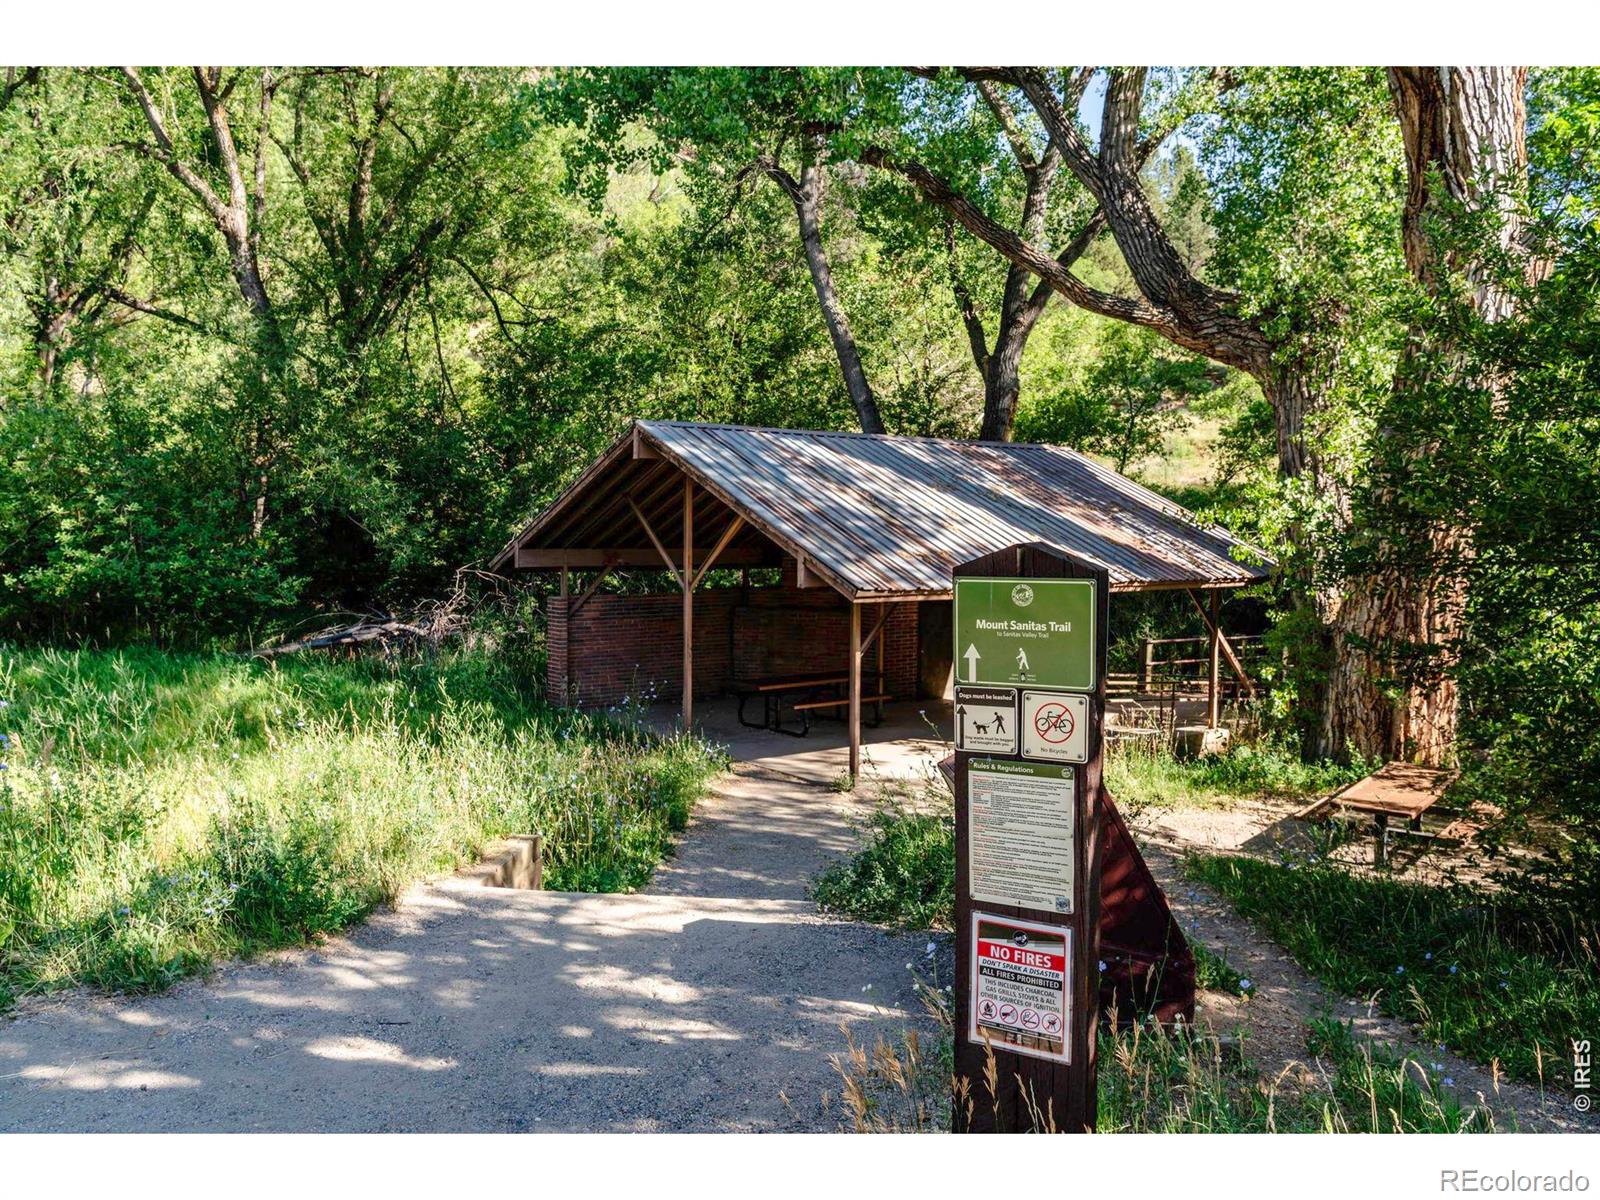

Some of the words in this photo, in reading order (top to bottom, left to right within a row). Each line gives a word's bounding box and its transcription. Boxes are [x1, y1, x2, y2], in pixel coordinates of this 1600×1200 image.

[976, 619, 1008, 630] Mount
[1010, 620, 1047, 631] Sanitas
[1049, 621, 1071, 632] Trail
[973, 762, 990, 770] Rules
[997, 765, 1034, 774] Regulations
[990, 945, 1010, 960] NO
[1014, 950, 1052, 968] FIRES
[982, 958, 1001, 967] DON'T
[1002, 962, 1022, 972] SPARK
[1029, 968, 1060, 980] DISASTER
[982, 968, 995, 976] ALL
[996, 971, 1015, 981] FIRES
[1017, 974, 1060, 989] PROHIBITED
[998, 981, 1024, 992] INCLUDES
[981, 991, 998, 1000] OTHER
[999, 995, 1024, 1007] SOURCES
[1018, 993, 1039, 1003] STOVES
[1045, 998, 1056, 1006] ALL
